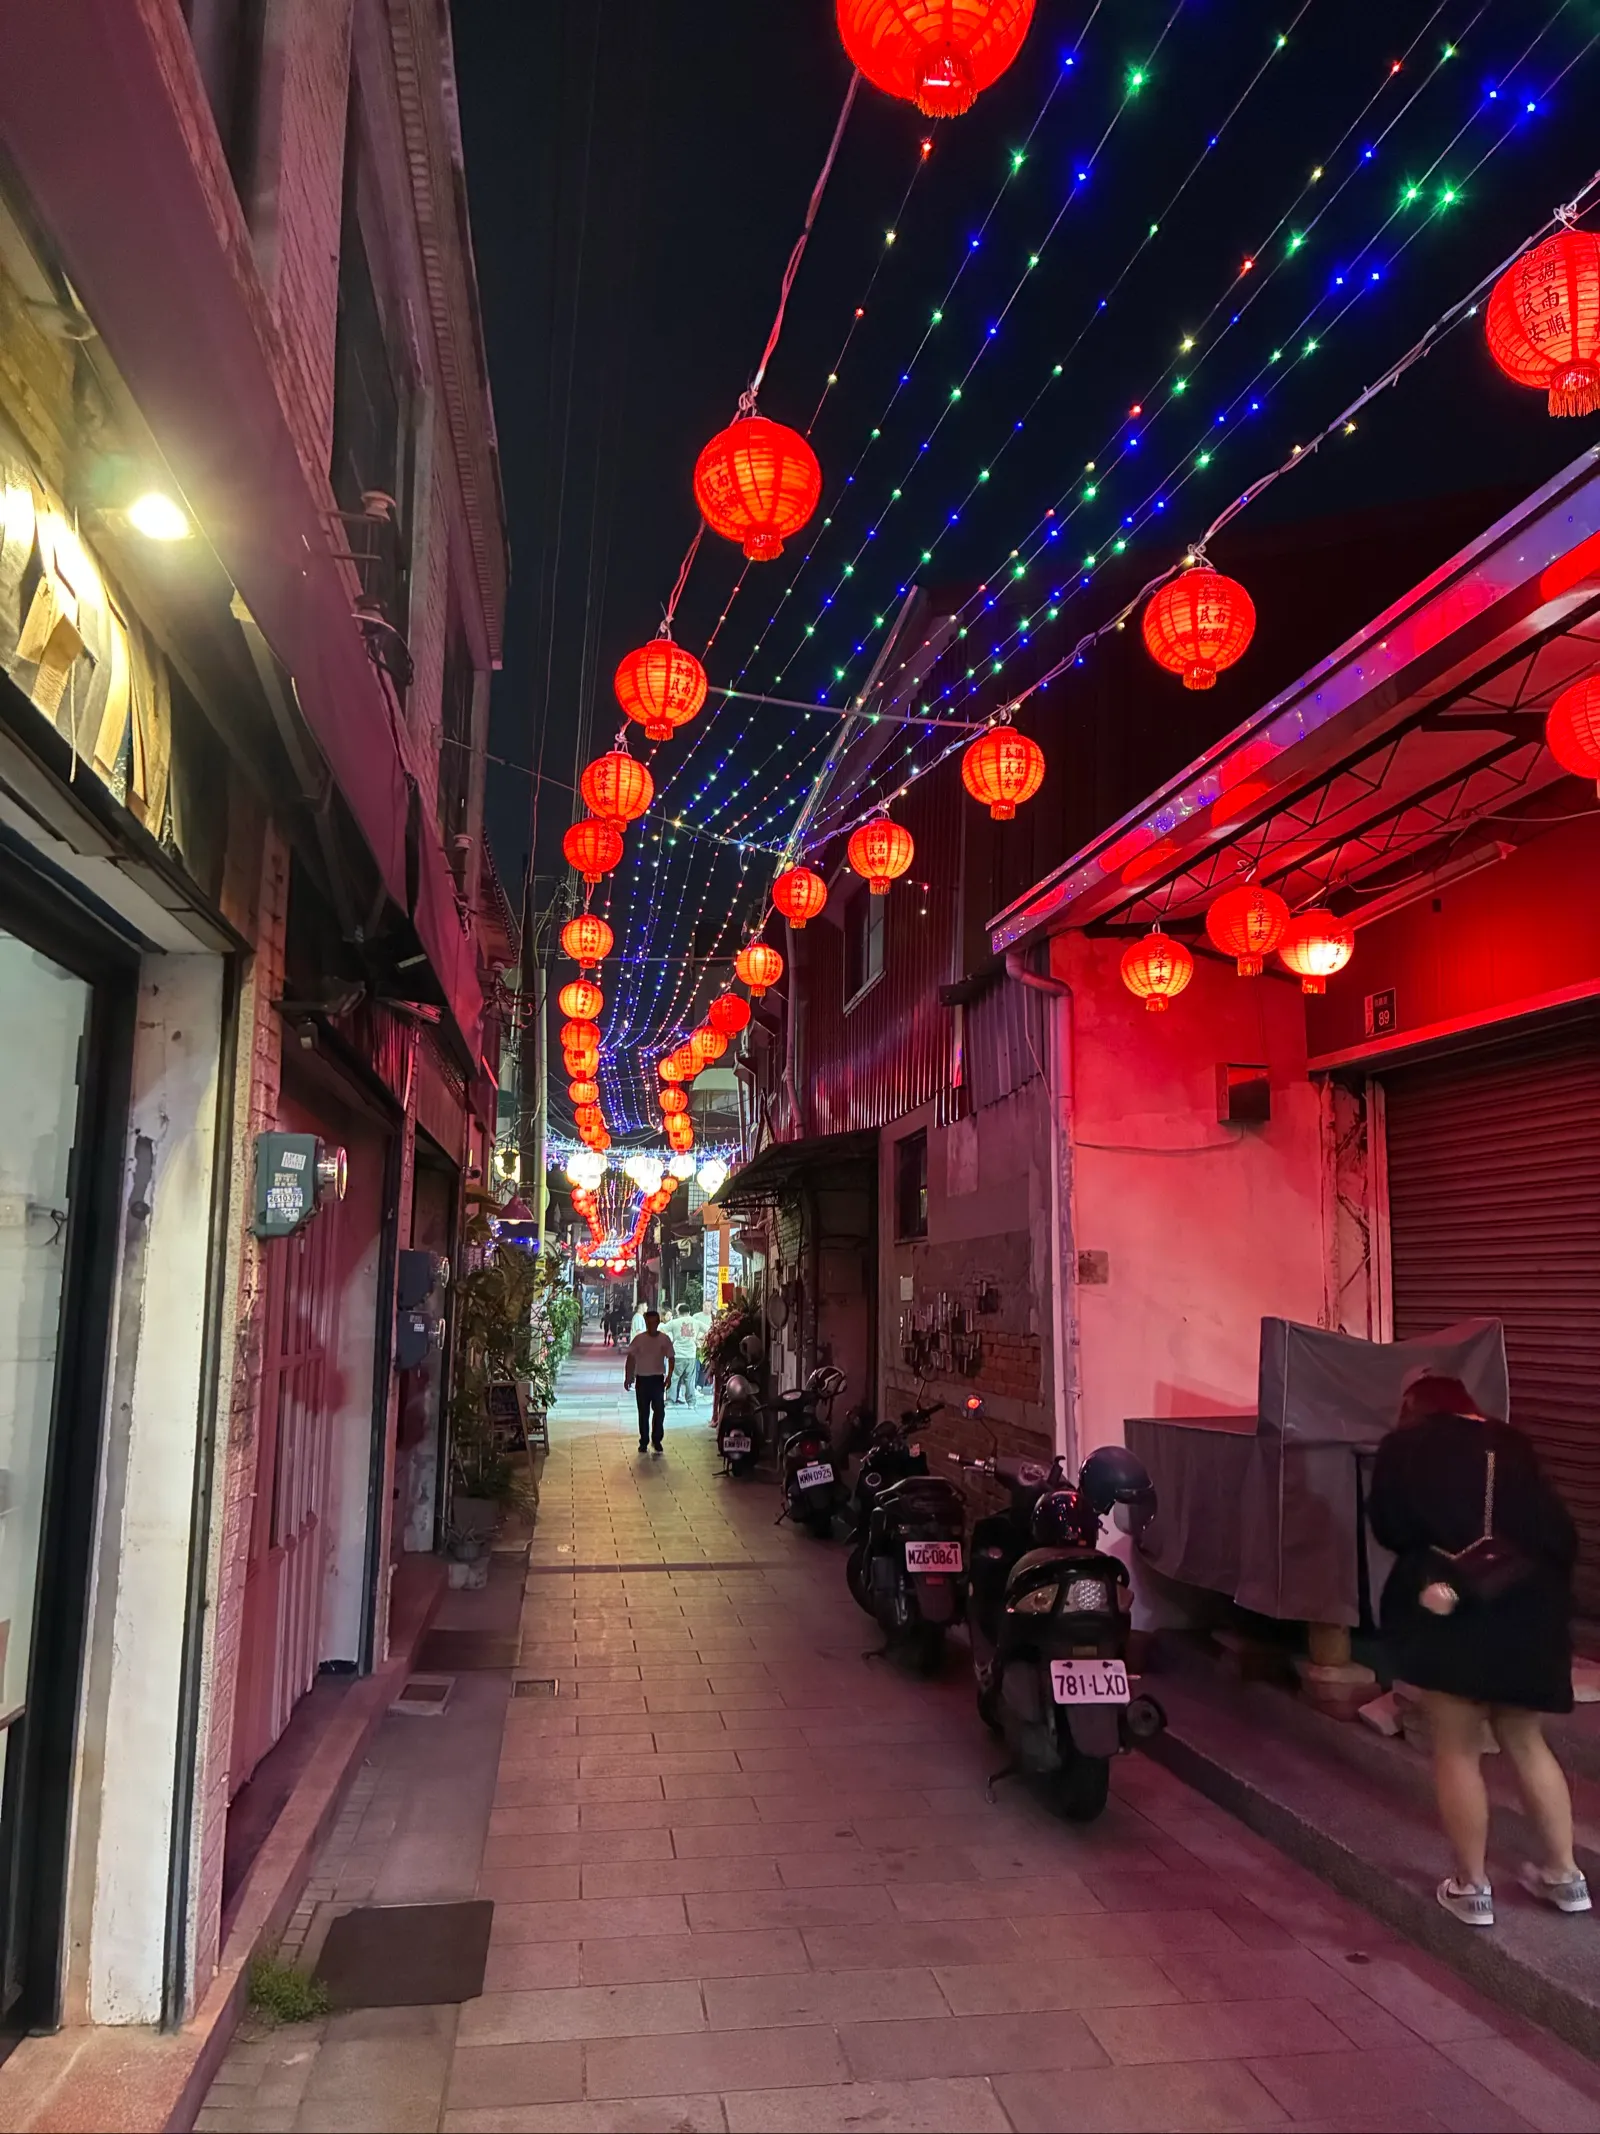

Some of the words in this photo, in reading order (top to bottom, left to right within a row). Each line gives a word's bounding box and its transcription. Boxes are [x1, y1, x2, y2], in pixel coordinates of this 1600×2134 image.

[1538, 242, 1569, 338] 風調雨順
[1378, 1010, 1390, 1026] 89
[269, 1194, 302, 1202] 2610399
